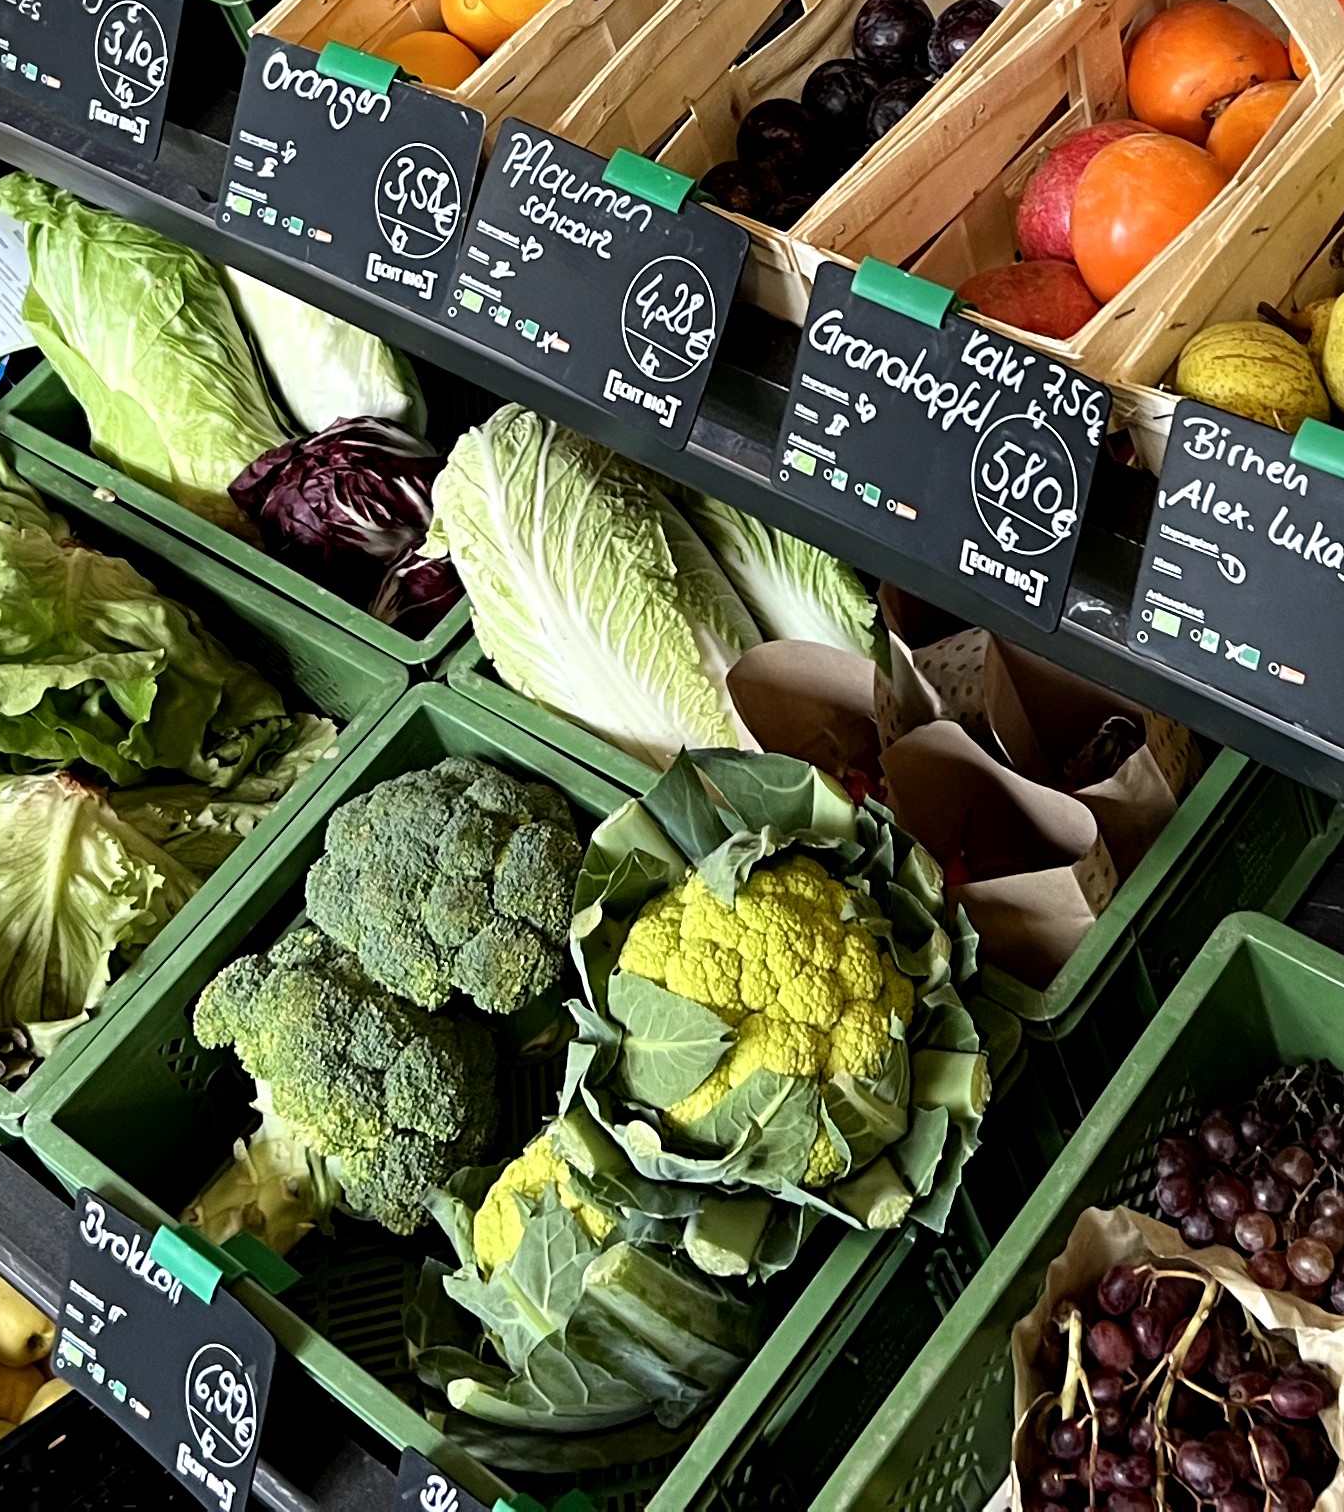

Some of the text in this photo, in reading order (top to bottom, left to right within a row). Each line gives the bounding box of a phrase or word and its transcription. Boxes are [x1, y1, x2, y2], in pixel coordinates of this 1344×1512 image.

[261, 51, 392, 130] Orangen
[502, 132, 653, 232] Pflaumen
[808, 309, 1000, 432] Granatapfel
[960, 329, 1037, 393] Kaki
[1183, 416, 1309, 497] Birnen
